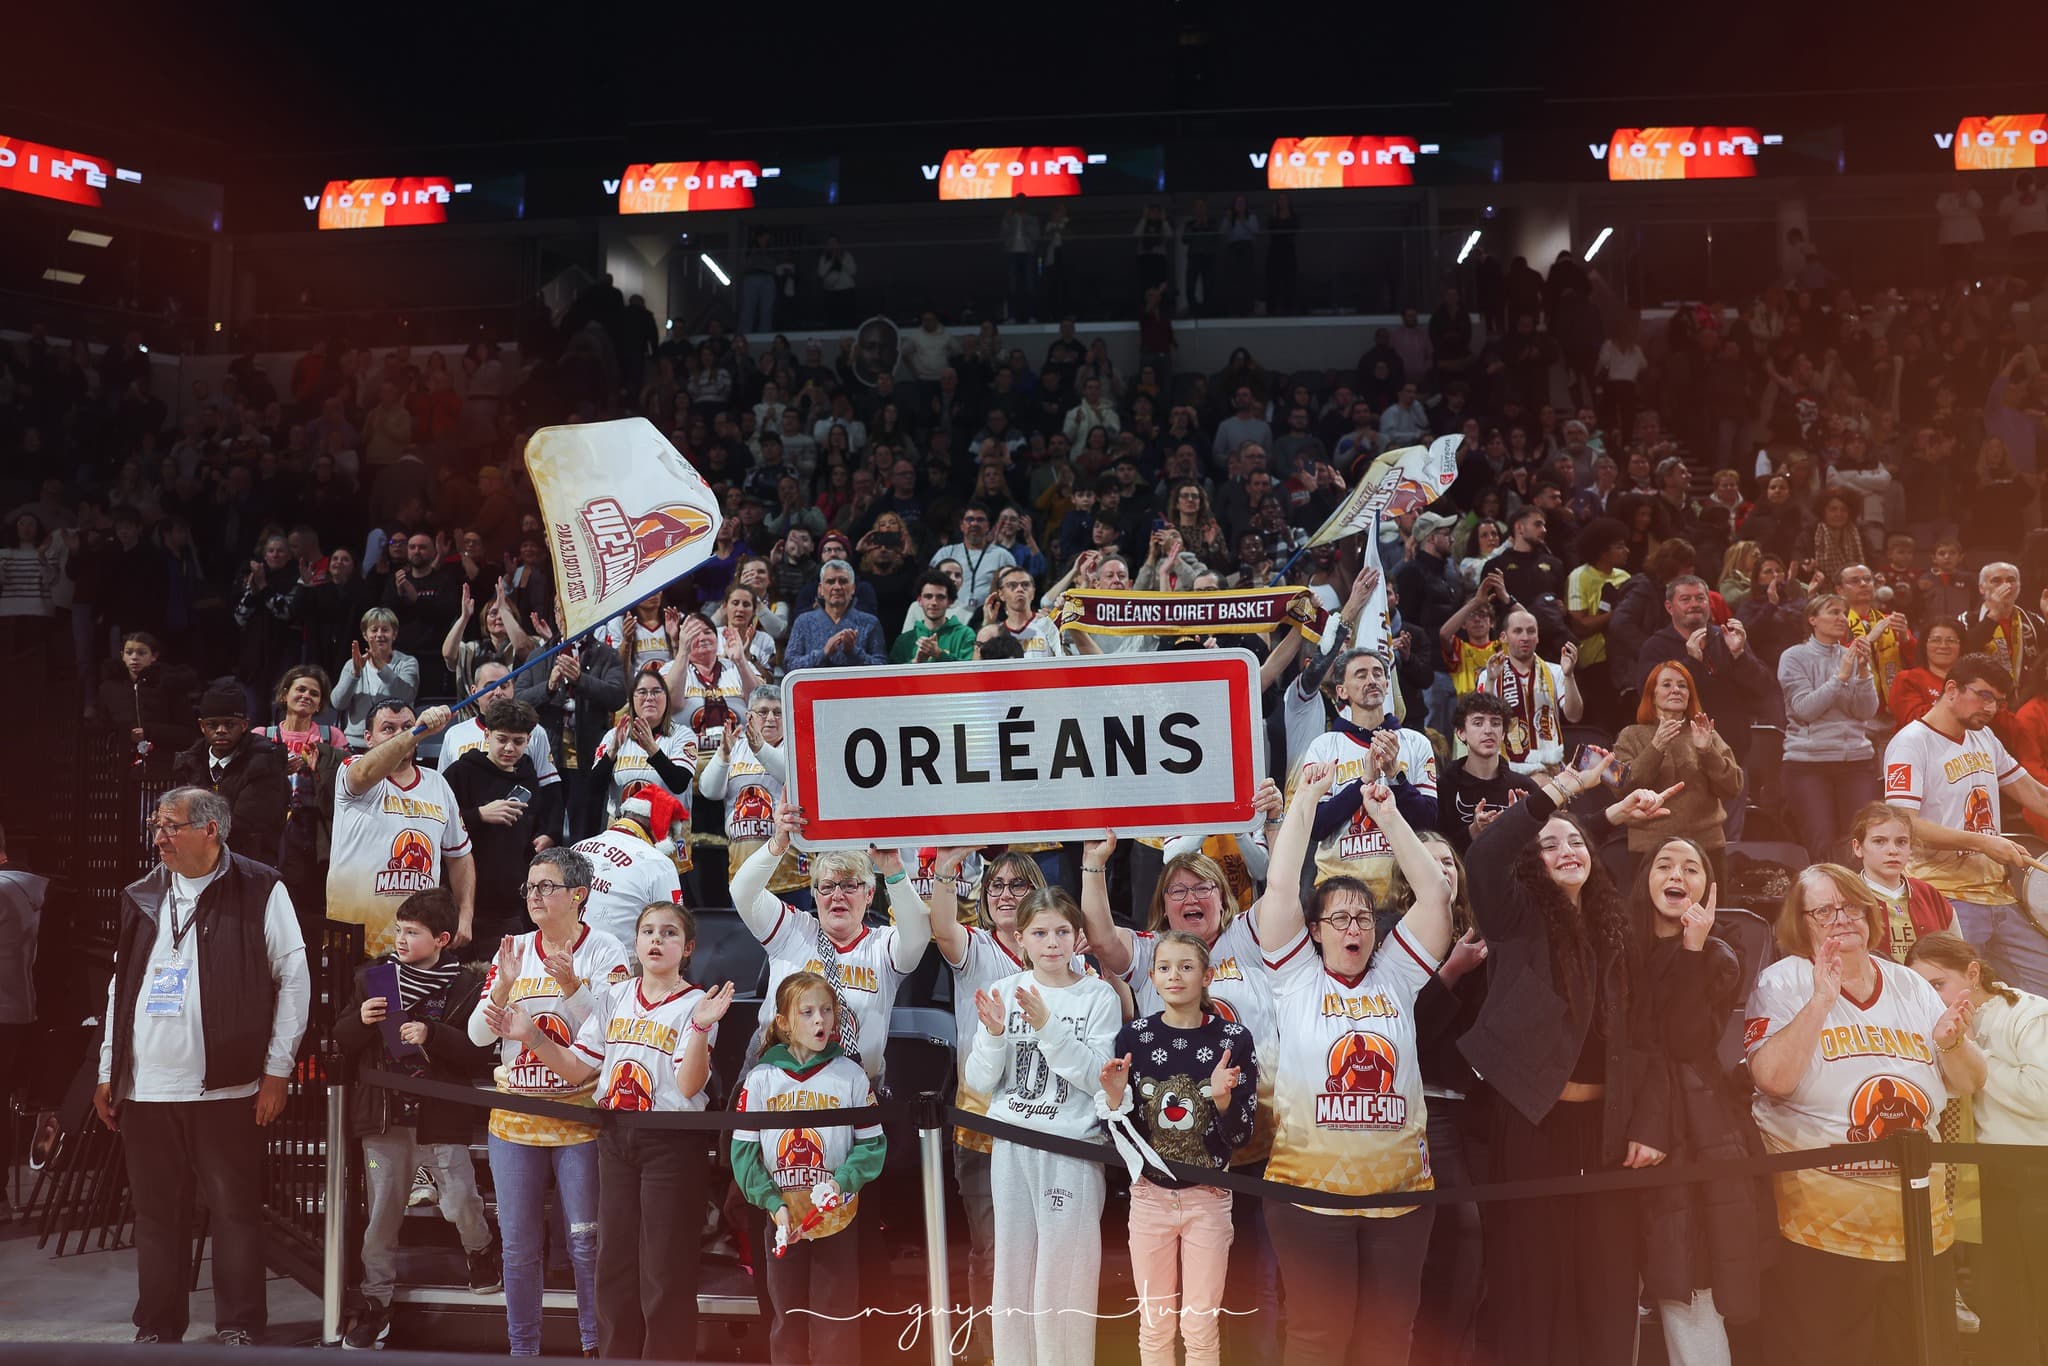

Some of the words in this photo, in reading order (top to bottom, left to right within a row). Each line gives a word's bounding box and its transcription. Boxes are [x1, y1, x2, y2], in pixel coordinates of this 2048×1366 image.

[1933, 129, 2048, 149] VICTO
[1096, 601, 1161, 622] ORLÉANS
[1164, 603, 1214, 621] LOIRET
[1218, 600, 1274, 619] BASKET
[843, 705, 1203, 788] ORLÉANS
[603, 846, 633, 868] SUP
[1820, 1023, 1933, 1065] ORLEANS
[1051, 1195, 1064, 1207] 75
